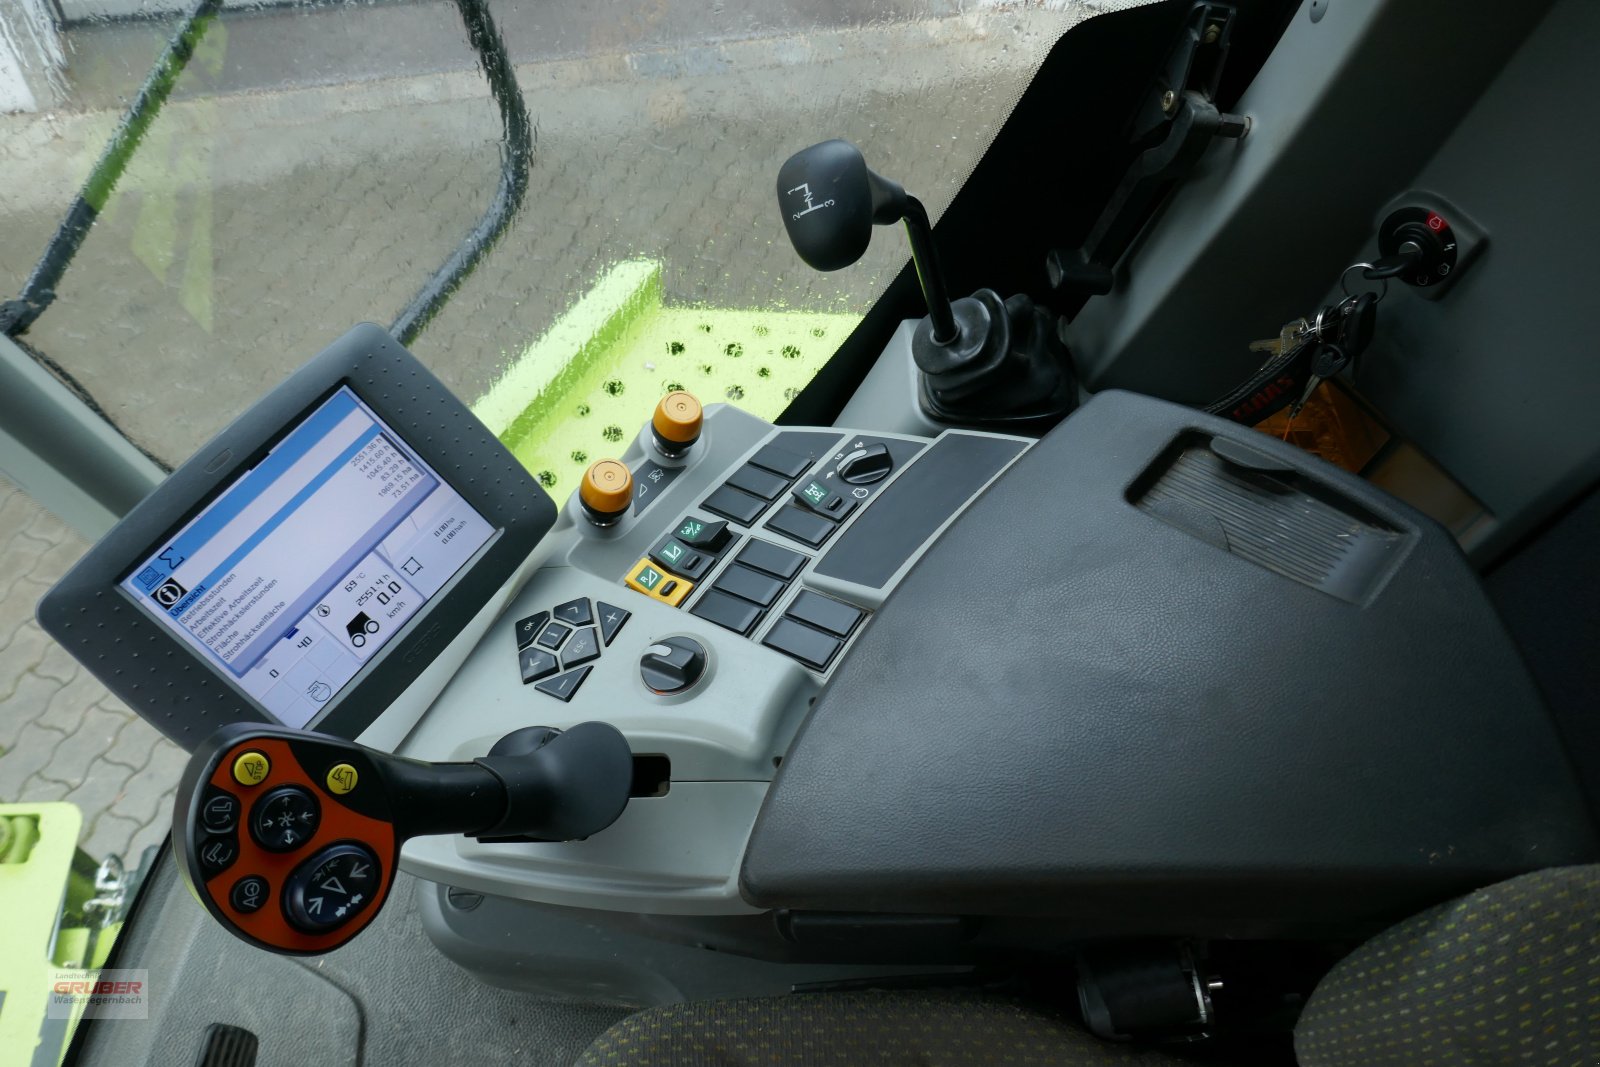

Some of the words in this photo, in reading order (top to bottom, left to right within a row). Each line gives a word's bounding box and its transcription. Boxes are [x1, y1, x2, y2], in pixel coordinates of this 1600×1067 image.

[824, 199, 835, 208] 3
[792, 212, 801, 221] 2
[180, 573, 236, 624] Betriebsstunden
[350, 442, 377, 467] 2551.36
[189, 597, 227, 632] Arbeitszeit
[359, 449, 385, 473] 1415.60
[197, 610, 229, 639] Effektive
[228, 577, 265, 611] Arbeitszeit
[366, 456, 392, 480] 1045.40
[206, 579, 278, 646] Strohhäckslerstunden
[380, 463, 399, 481] 83.29
[222, 601, 286, 660] Strohhäckselfläche
[391, 481, 410, 498] 73.51
[344, 580, 358, 593] 69
[355, 579, 385, 607] 2551.4
[376, 580, 402, 606] 0.0
[171, 585, 206, 616] Übersicht
[388, 601, 407, 620] km/h
[524, 621, 535, 631] OK
[214, 630, 239, 653] Fläche
[297, 636, 313, 649] 40
[573, 639, 587, 653] ESC
[269, 669, 280, 679] 0
[253, 761, 265, 781] STOP
